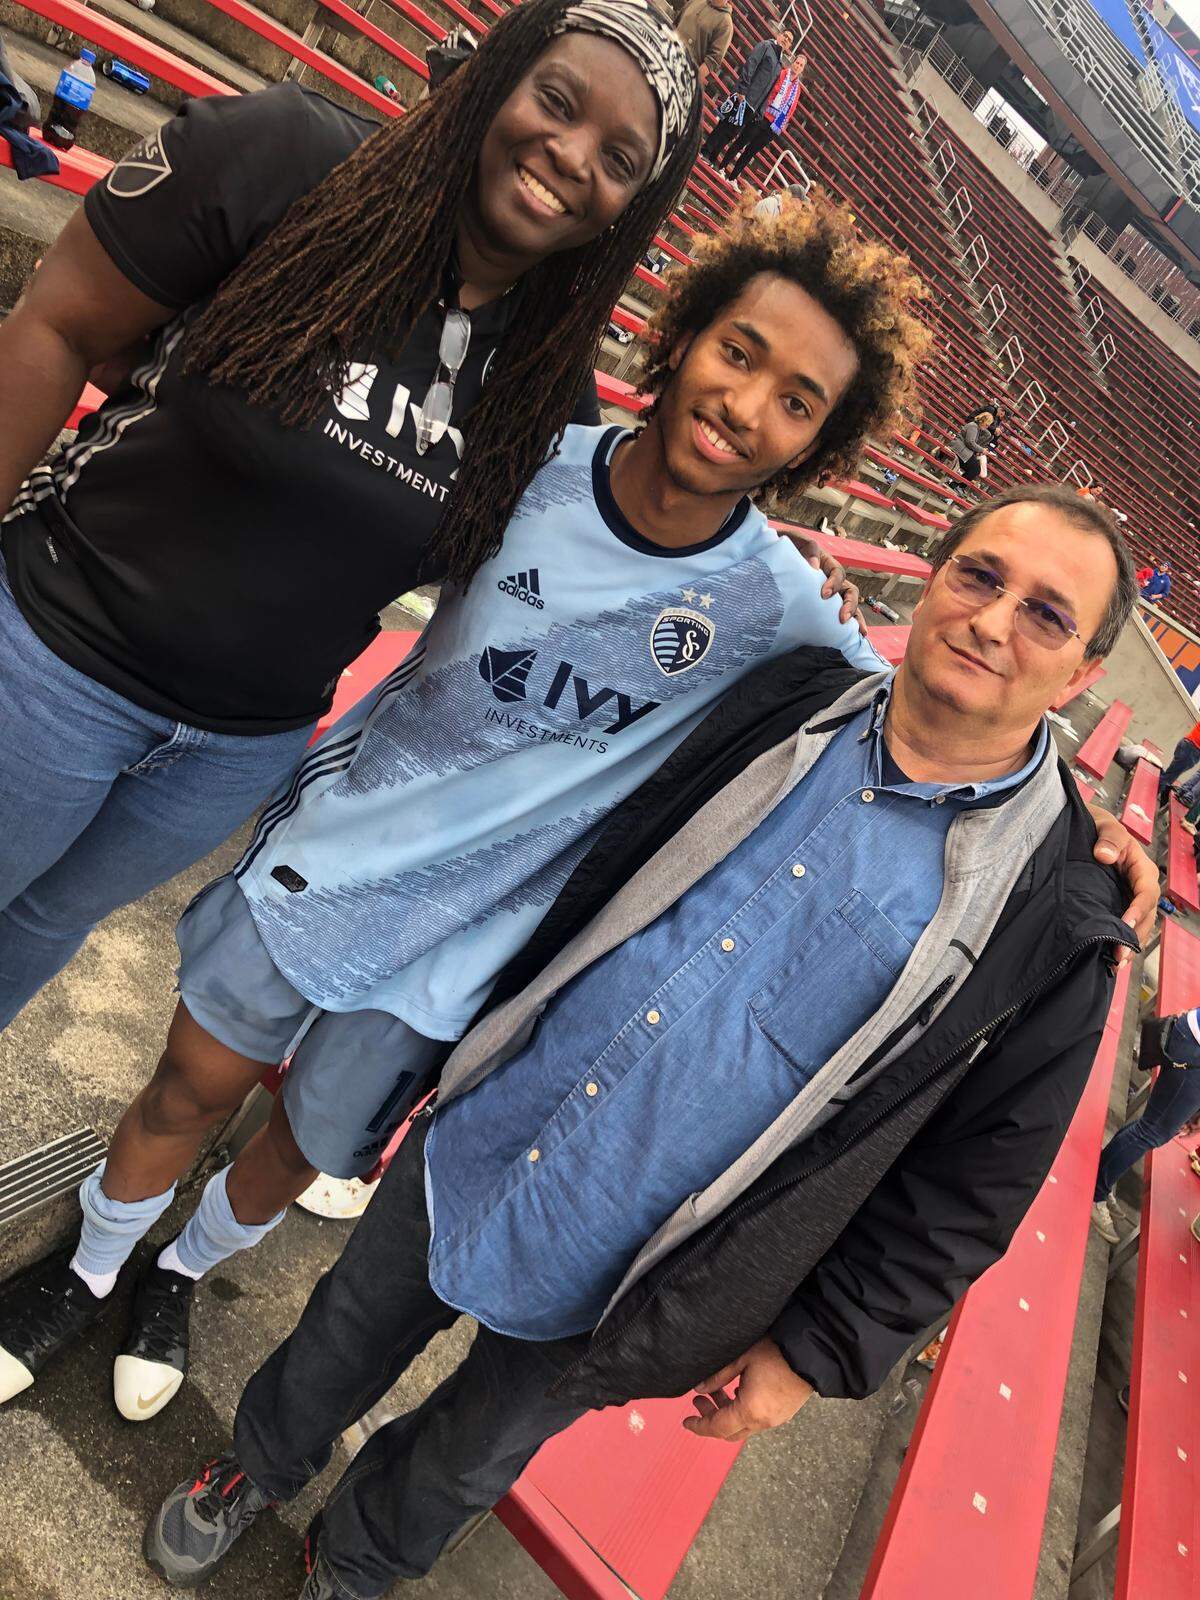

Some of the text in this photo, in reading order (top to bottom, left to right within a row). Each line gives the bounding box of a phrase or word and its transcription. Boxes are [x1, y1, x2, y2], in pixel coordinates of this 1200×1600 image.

[497, 580, 545, 610] adidas
[661, 616, 709, 637] SPORTING
[543, 660, 662, 735] Ivy
[484, 707, 609, 754] INVESTMENTS
